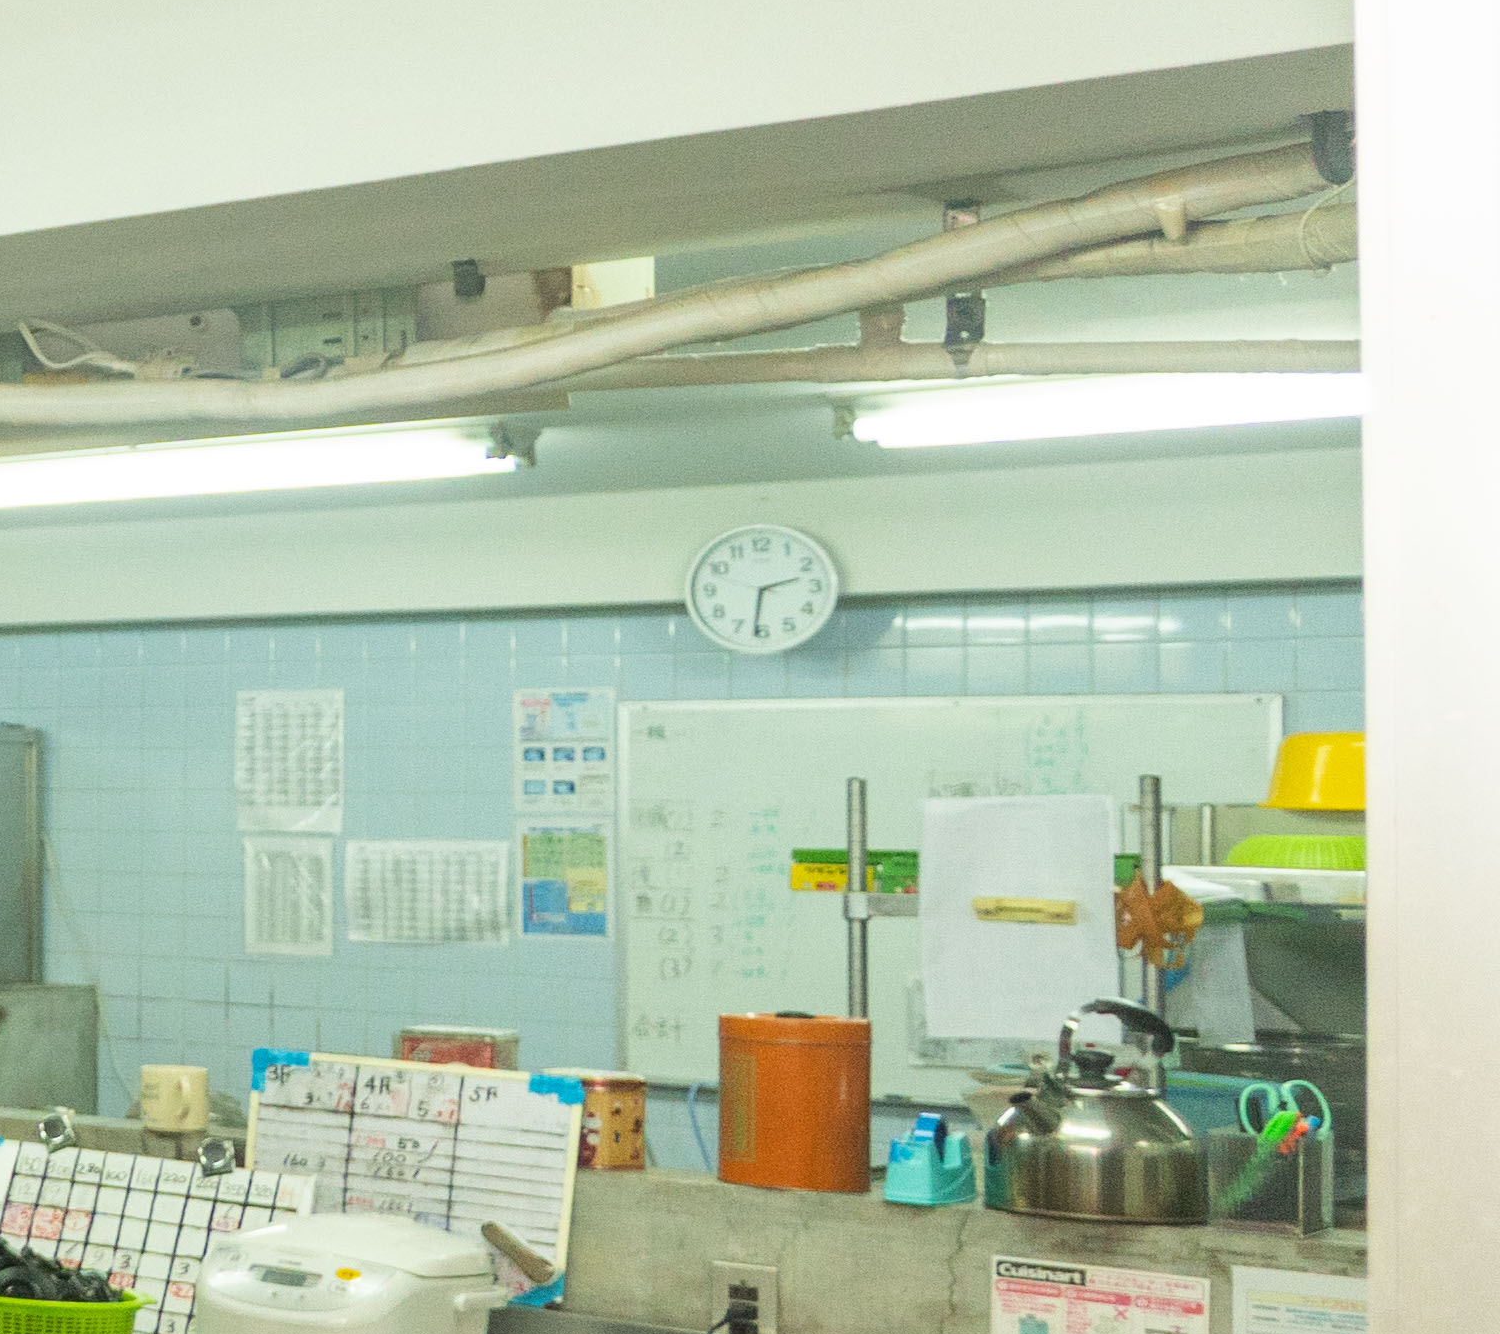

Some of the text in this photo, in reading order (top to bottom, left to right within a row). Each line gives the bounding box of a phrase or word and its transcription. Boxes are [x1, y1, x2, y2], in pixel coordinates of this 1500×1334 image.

[729, 544, 745, 559] 11
[752, 537, 770, 552] 12
[783, 541, 791, 556] 1
[710, 560, 729, 575] 10
[800, 556, 813, 571] 2
[703, 582, 717, 597] 9
[810, 578, 822, 593] 3
[713, 603, 725, 618] 8
[800, 601, 813, 615] 4
[732, 618, 745, 633] 7
[782, 617, 796, 632] 5
[267, 1063, 292, 1085] 3F
[469, 1085, 498, 1102] 5F
[999, 1262, 1083, 1285] Cuisinart
